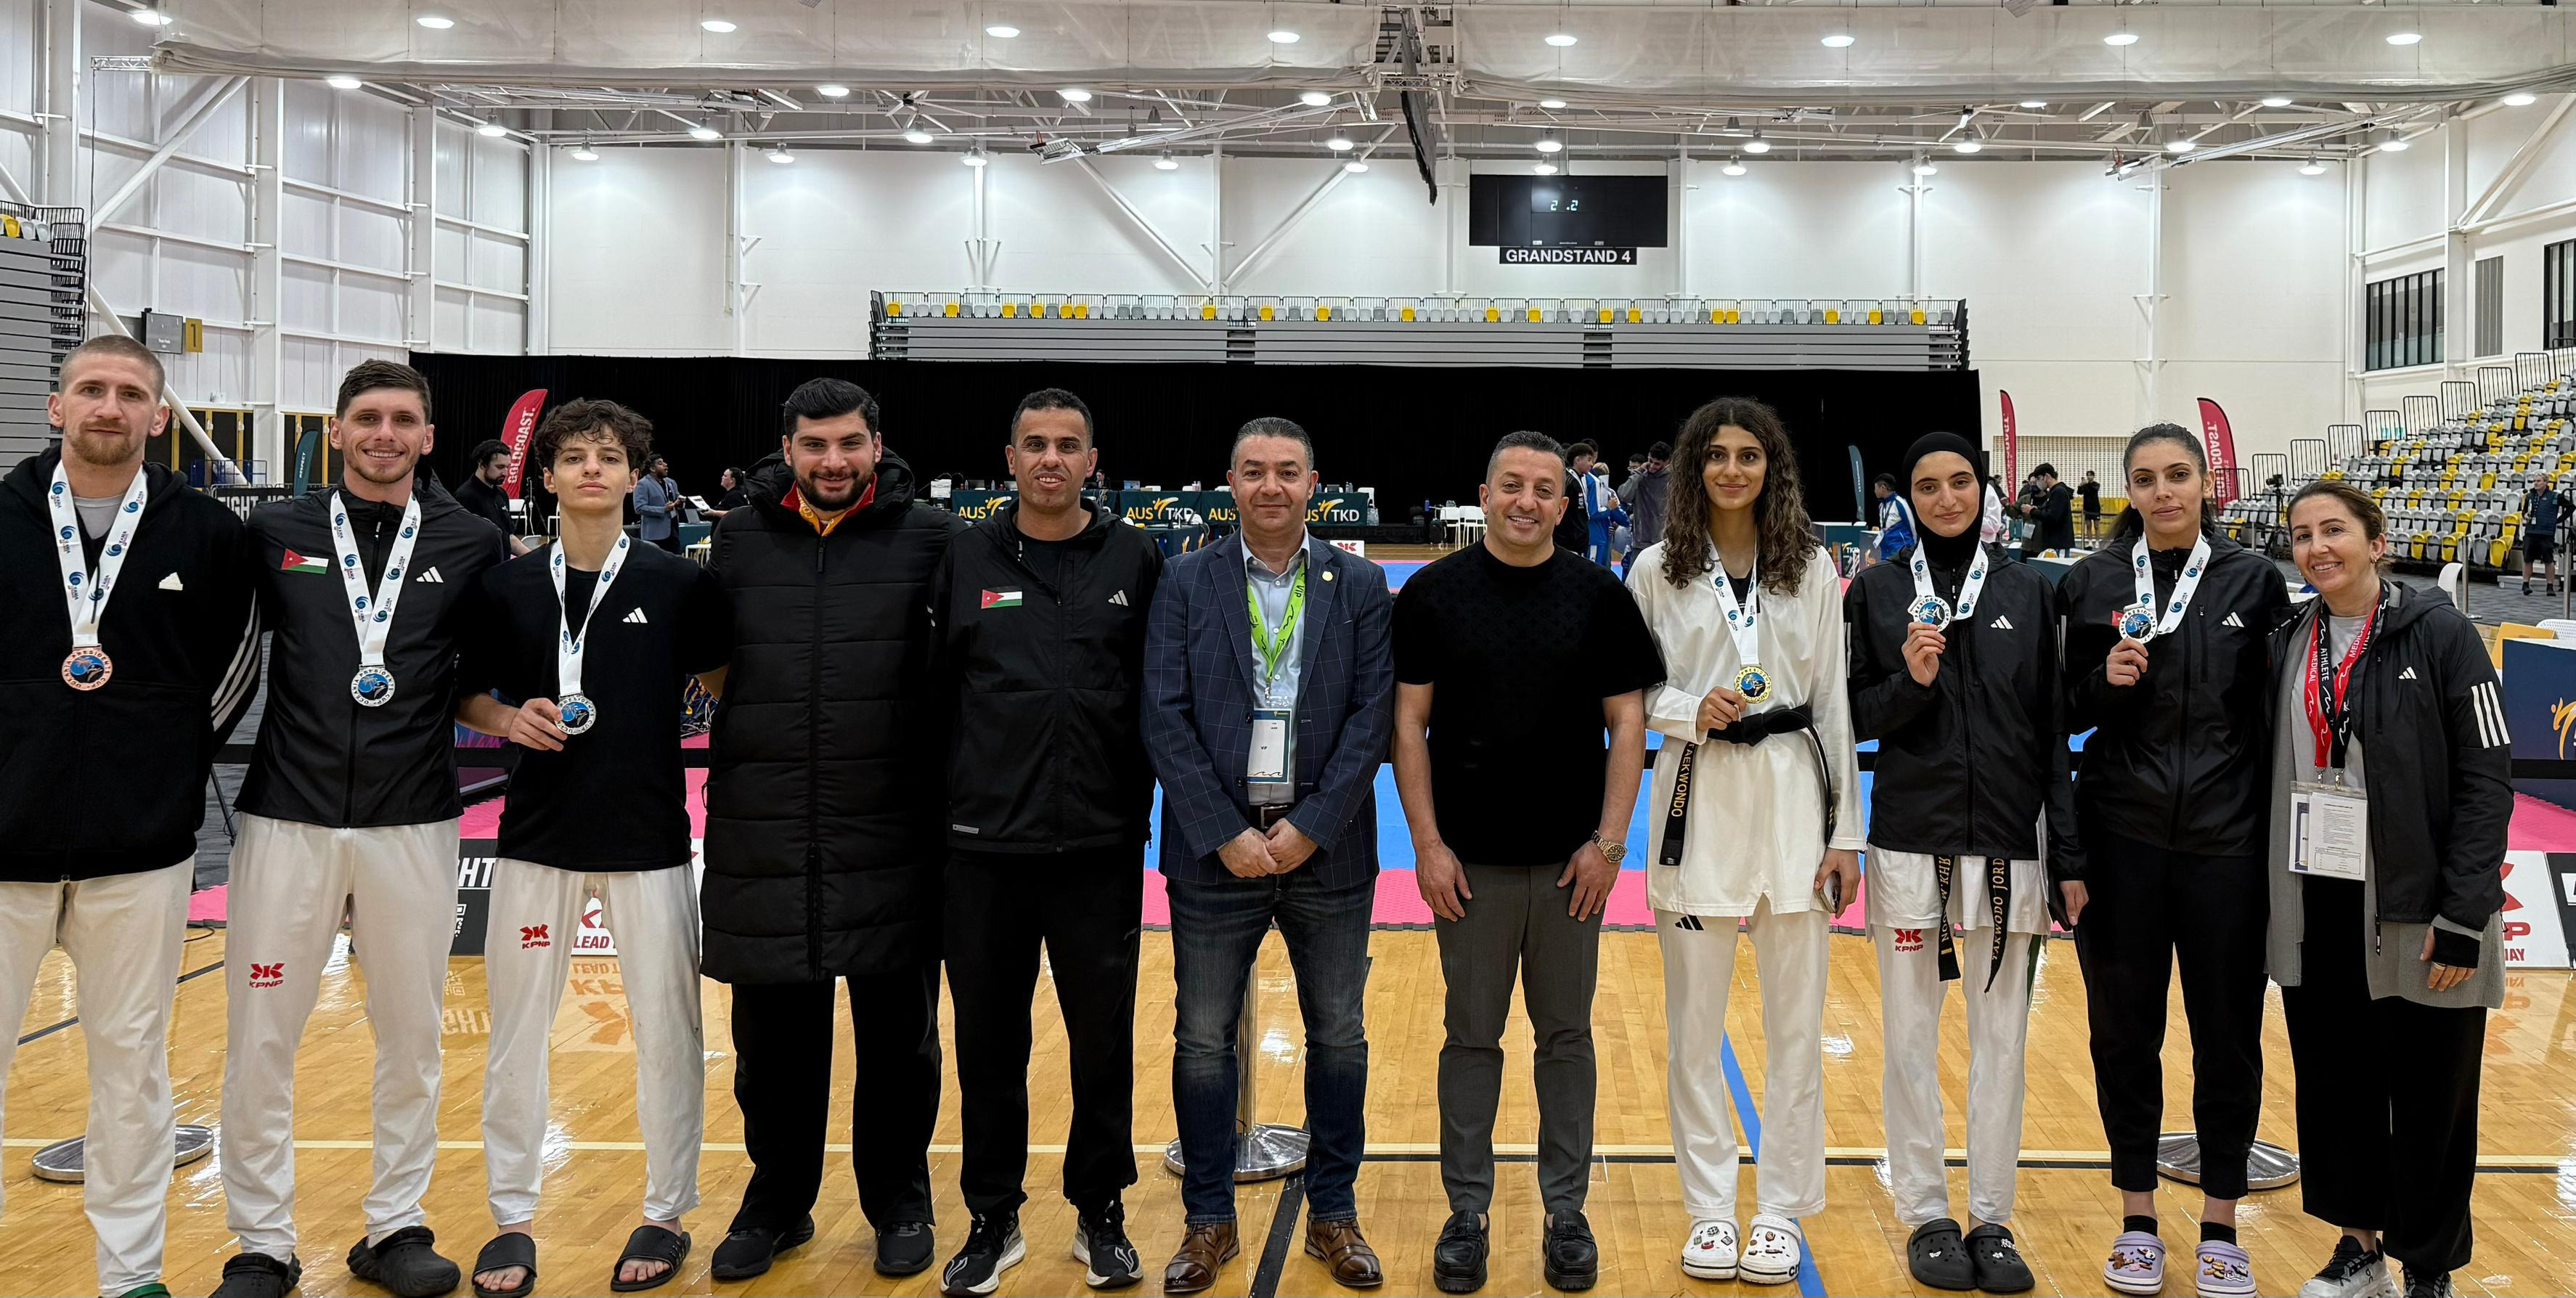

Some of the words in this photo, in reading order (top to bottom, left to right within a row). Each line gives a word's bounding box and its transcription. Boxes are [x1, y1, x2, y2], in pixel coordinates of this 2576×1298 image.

[1506, 250, 1618, 263] GRANDSTAND
[1621, 250, 1631, 263] 4
[190, 323, 196, 347] 1
[958, 507, 987, 519] AUS
[1126, 507, 1154, 520] AUS
[1208, 508, 1236, 521] AUS
[1305, 510, 1319, 522] US
[1331, 510, 1360, 522] TKD
[1295, 585, 1305, 597] VIP
[2308, 650, 2318, 684] MEDICAL
[2320, 648, 2330, 682] ATHLETE
[1671, 743, 1695, 817] TAEKWONDO
[573, 936, 610, 949] LEAD
